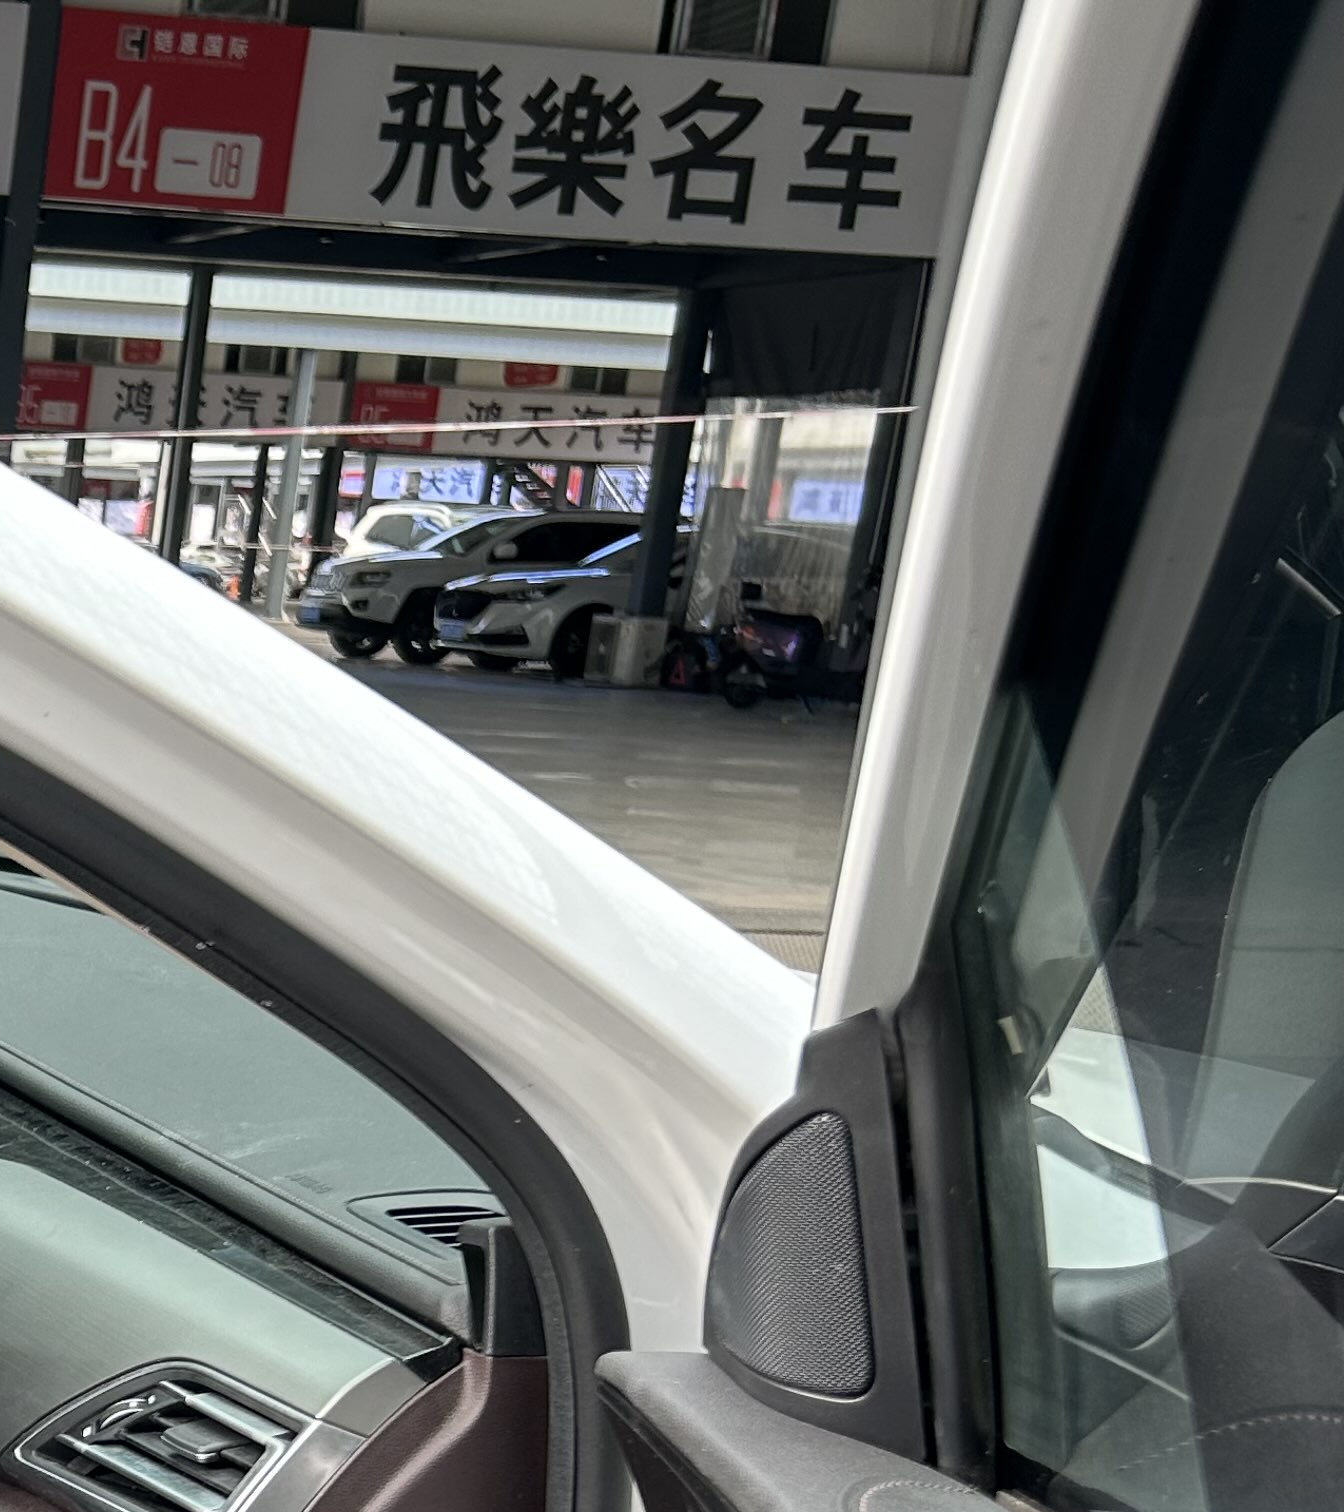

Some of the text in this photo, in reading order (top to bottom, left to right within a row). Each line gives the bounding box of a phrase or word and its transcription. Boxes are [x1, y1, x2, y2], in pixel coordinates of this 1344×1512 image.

[369, 64, 913, 231] 飛樂名车
[462, 399, 655, 451] 鸿天汽车
